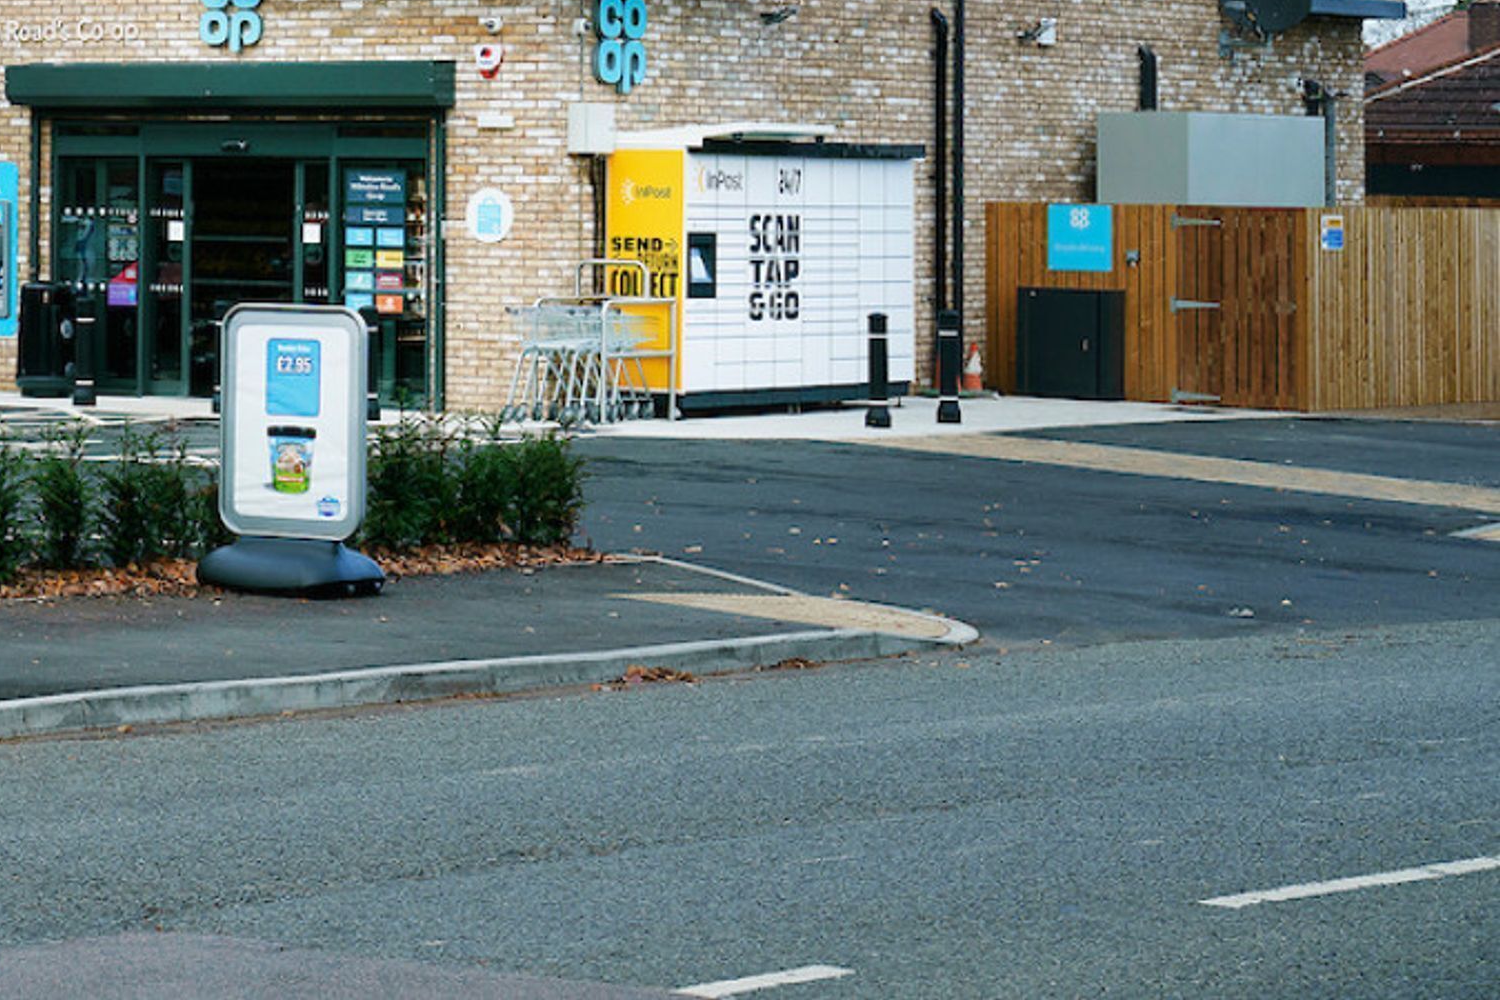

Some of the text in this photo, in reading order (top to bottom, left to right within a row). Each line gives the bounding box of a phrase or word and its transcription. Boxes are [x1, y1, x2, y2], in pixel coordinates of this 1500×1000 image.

[706, 168, 743, 191] InPost
[611, 236, 663, 252] SEND
[749, 213, 800, 254] SCAN
[611, 269, 679, 297] COLECT
[749, 259, 800, 289] TAP
[768, 290, 800, 321] GO
